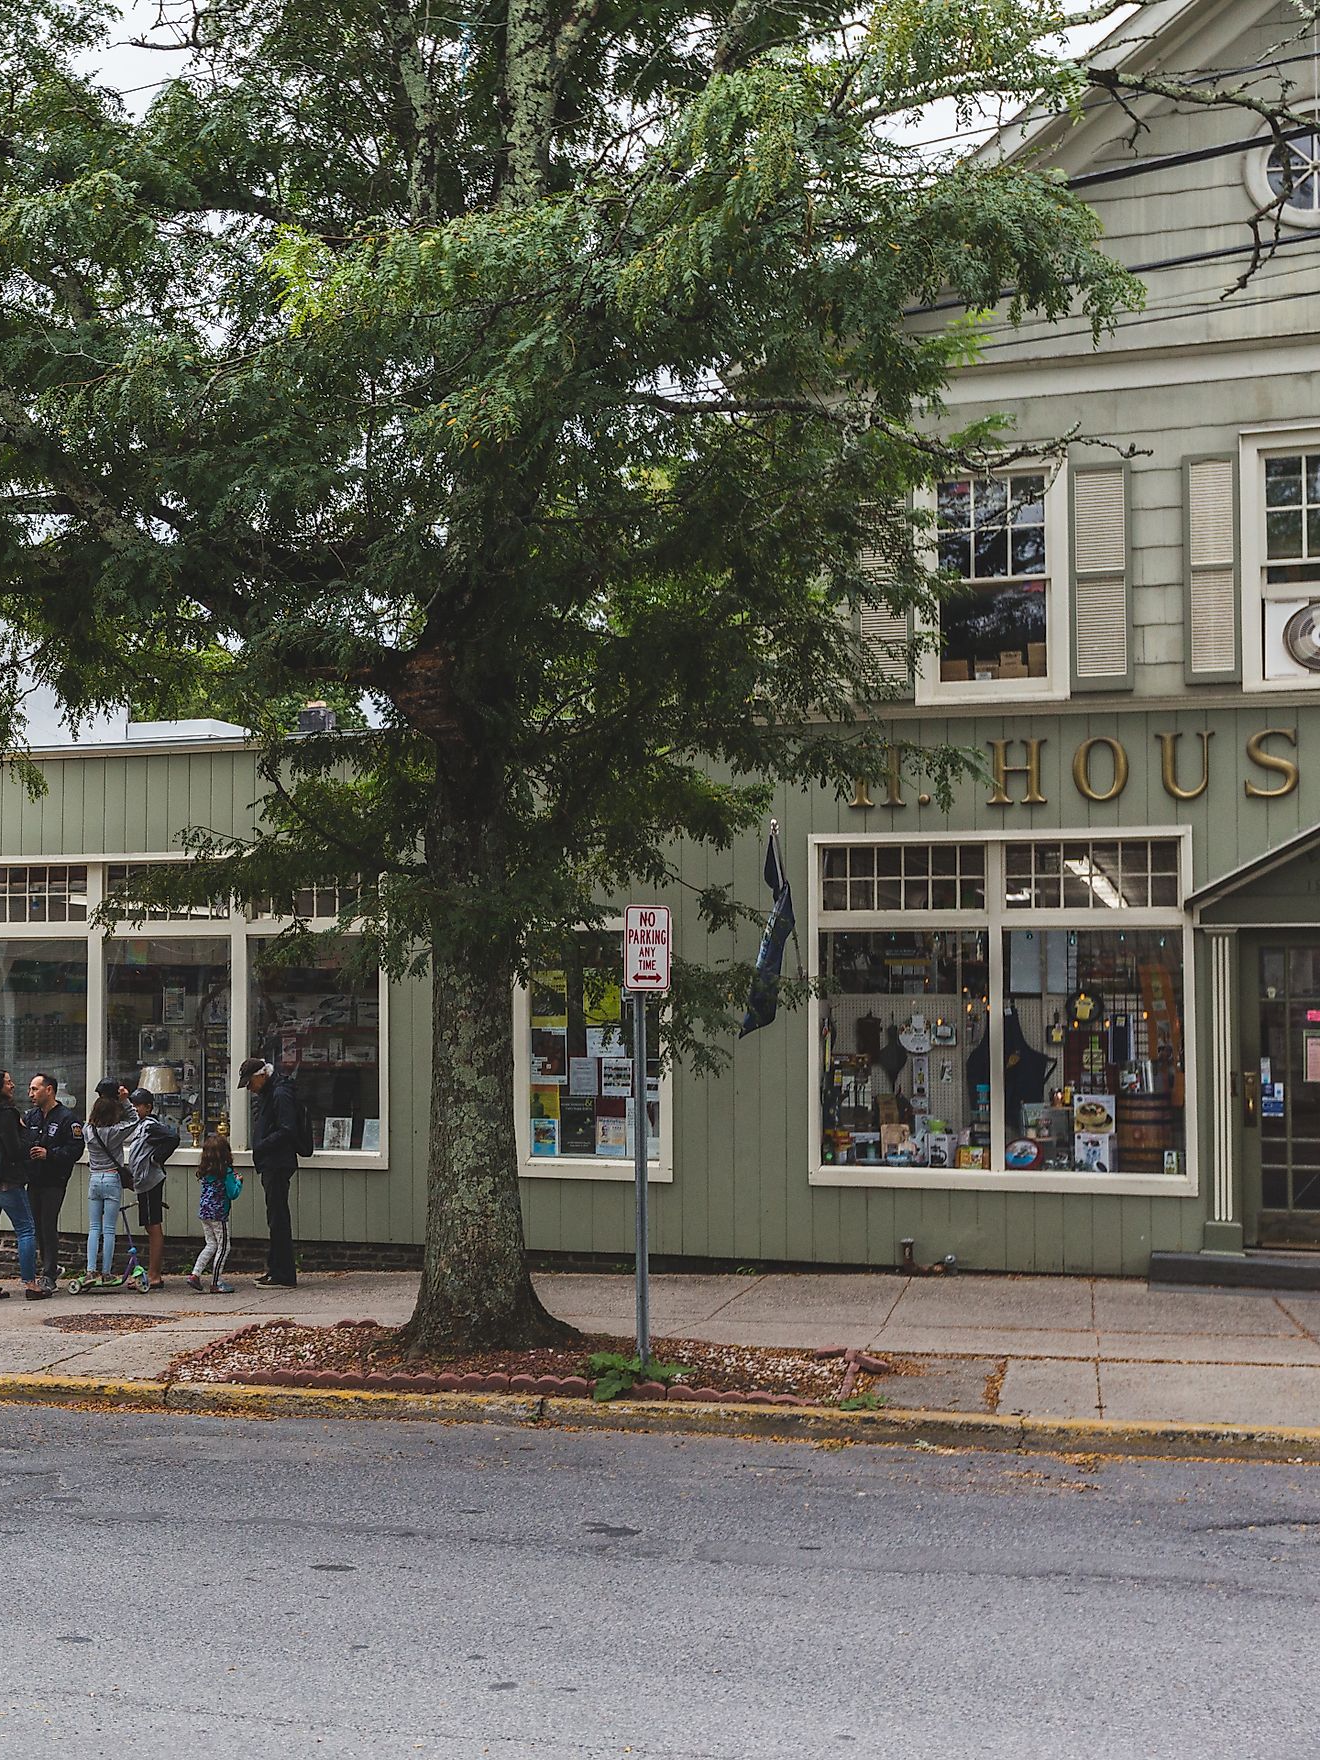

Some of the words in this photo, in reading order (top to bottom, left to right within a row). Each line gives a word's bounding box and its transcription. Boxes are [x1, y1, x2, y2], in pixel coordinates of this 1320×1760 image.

[986, 728, 1300, 805] HOUS
[640, 911, 656, 927] NO
[628, 928, 667, 945] PARKING
[639, 946, 656, 957] ANY
[638, 960, 657, 970] TIME
